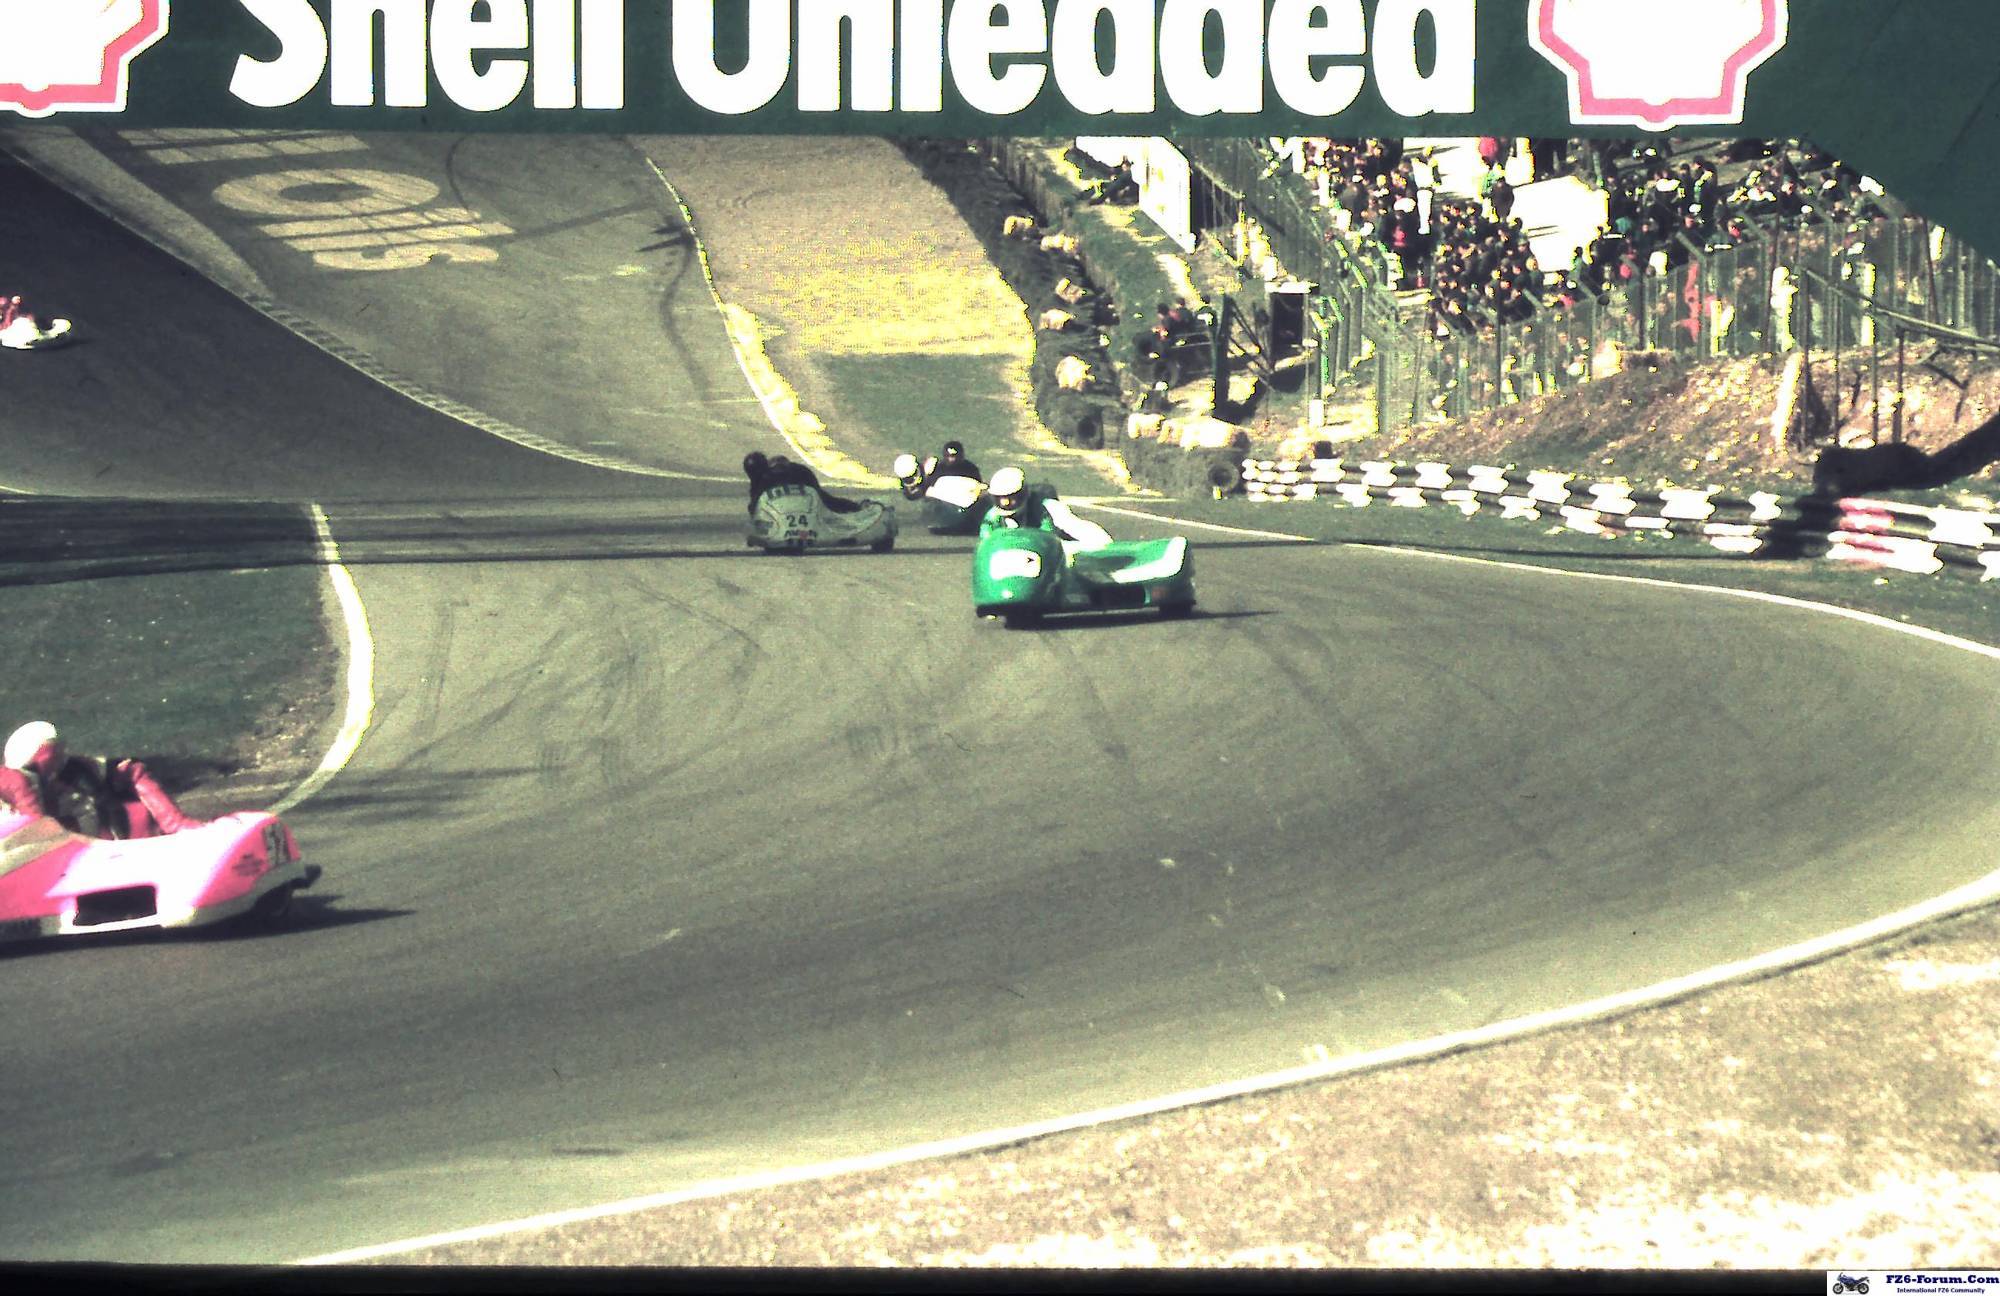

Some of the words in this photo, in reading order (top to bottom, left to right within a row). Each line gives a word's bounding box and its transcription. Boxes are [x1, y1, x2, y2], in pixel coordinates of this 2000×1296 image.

[229, 0, 623, 111] Shell
[672, 0, 1476, 116] Unleaded
[786, 515, 808, 527] 24
